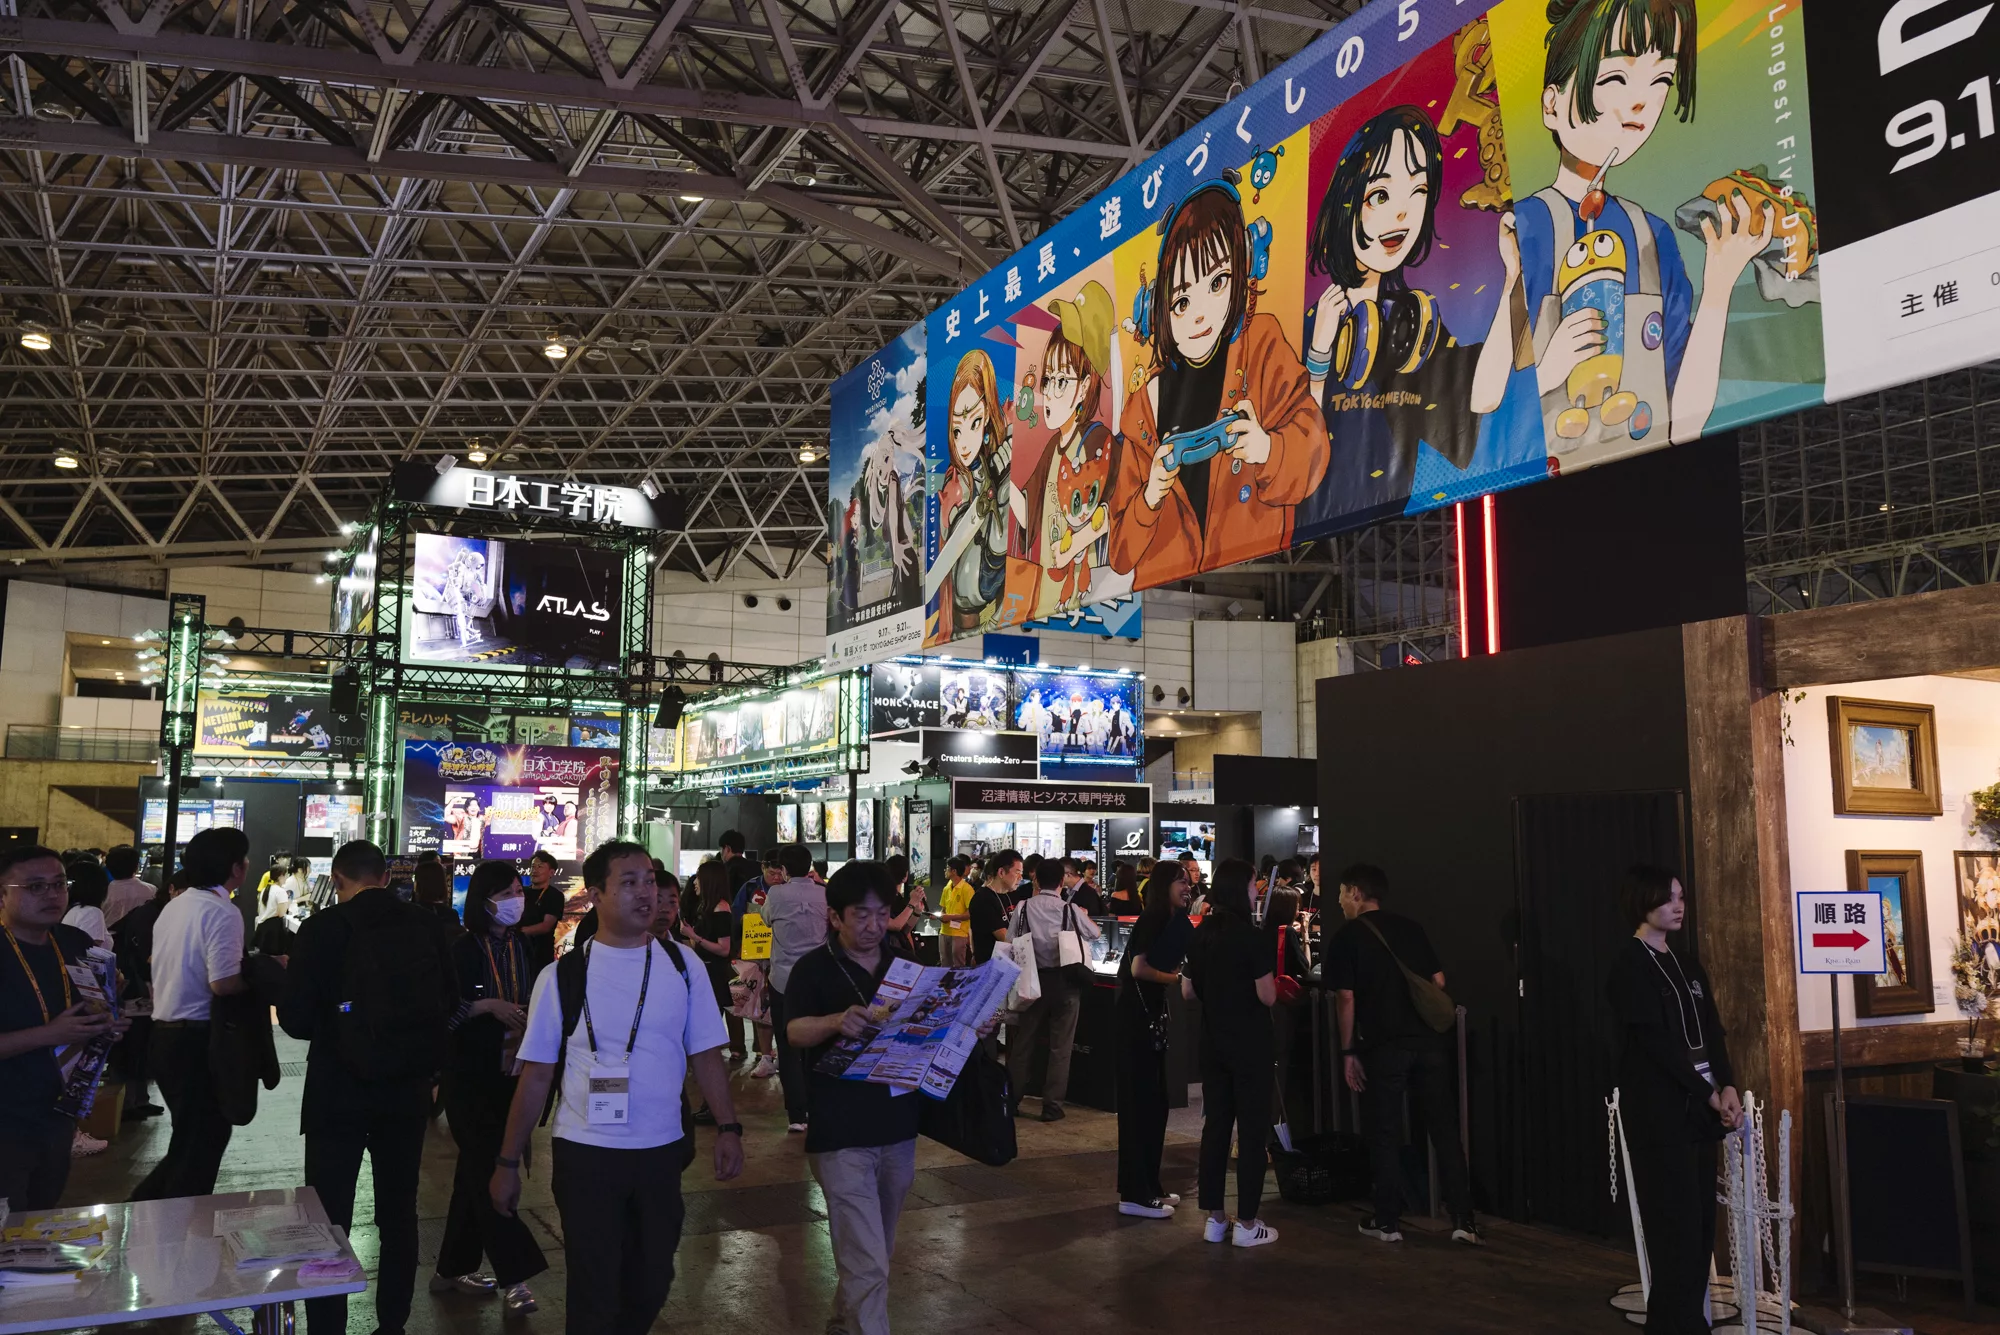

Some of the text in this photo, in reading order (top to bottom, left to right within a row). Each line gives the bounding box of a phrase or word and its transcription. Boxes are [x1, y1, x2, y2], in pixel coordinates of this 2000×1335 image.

[1885, 76, 2000, 174] 9.1
[1767, 4, 1801, 284] Longest Five Days
[945, 0, 1464, 342] 史上最長、遊びづくしの5
[1900, 280, 1960, 318] 主催
[864, 397, 888, 416] MABINOGI
[465, 473, 627, 522] 日本工学院
[536, 594, 610, 622] ATLAS
[844, 643, 867, 657] 幕張メッセ
[870, 643, 883, 651] TOKYO
[895, 635, 908, 645] SHOW
[1022, 649, 1031, 664] 1
[204, 711, 241, 727] NETHMI
[213, 719, 255, 735] with me
[524, 759, 586, 774] 日本工学院
[940, 753, 1020, 766] Creators Episode-Zero
[981, 788, 1126, 806] 沼津情報・ビジネス専門学校
[1814, 902, 1867, 925] 順路
